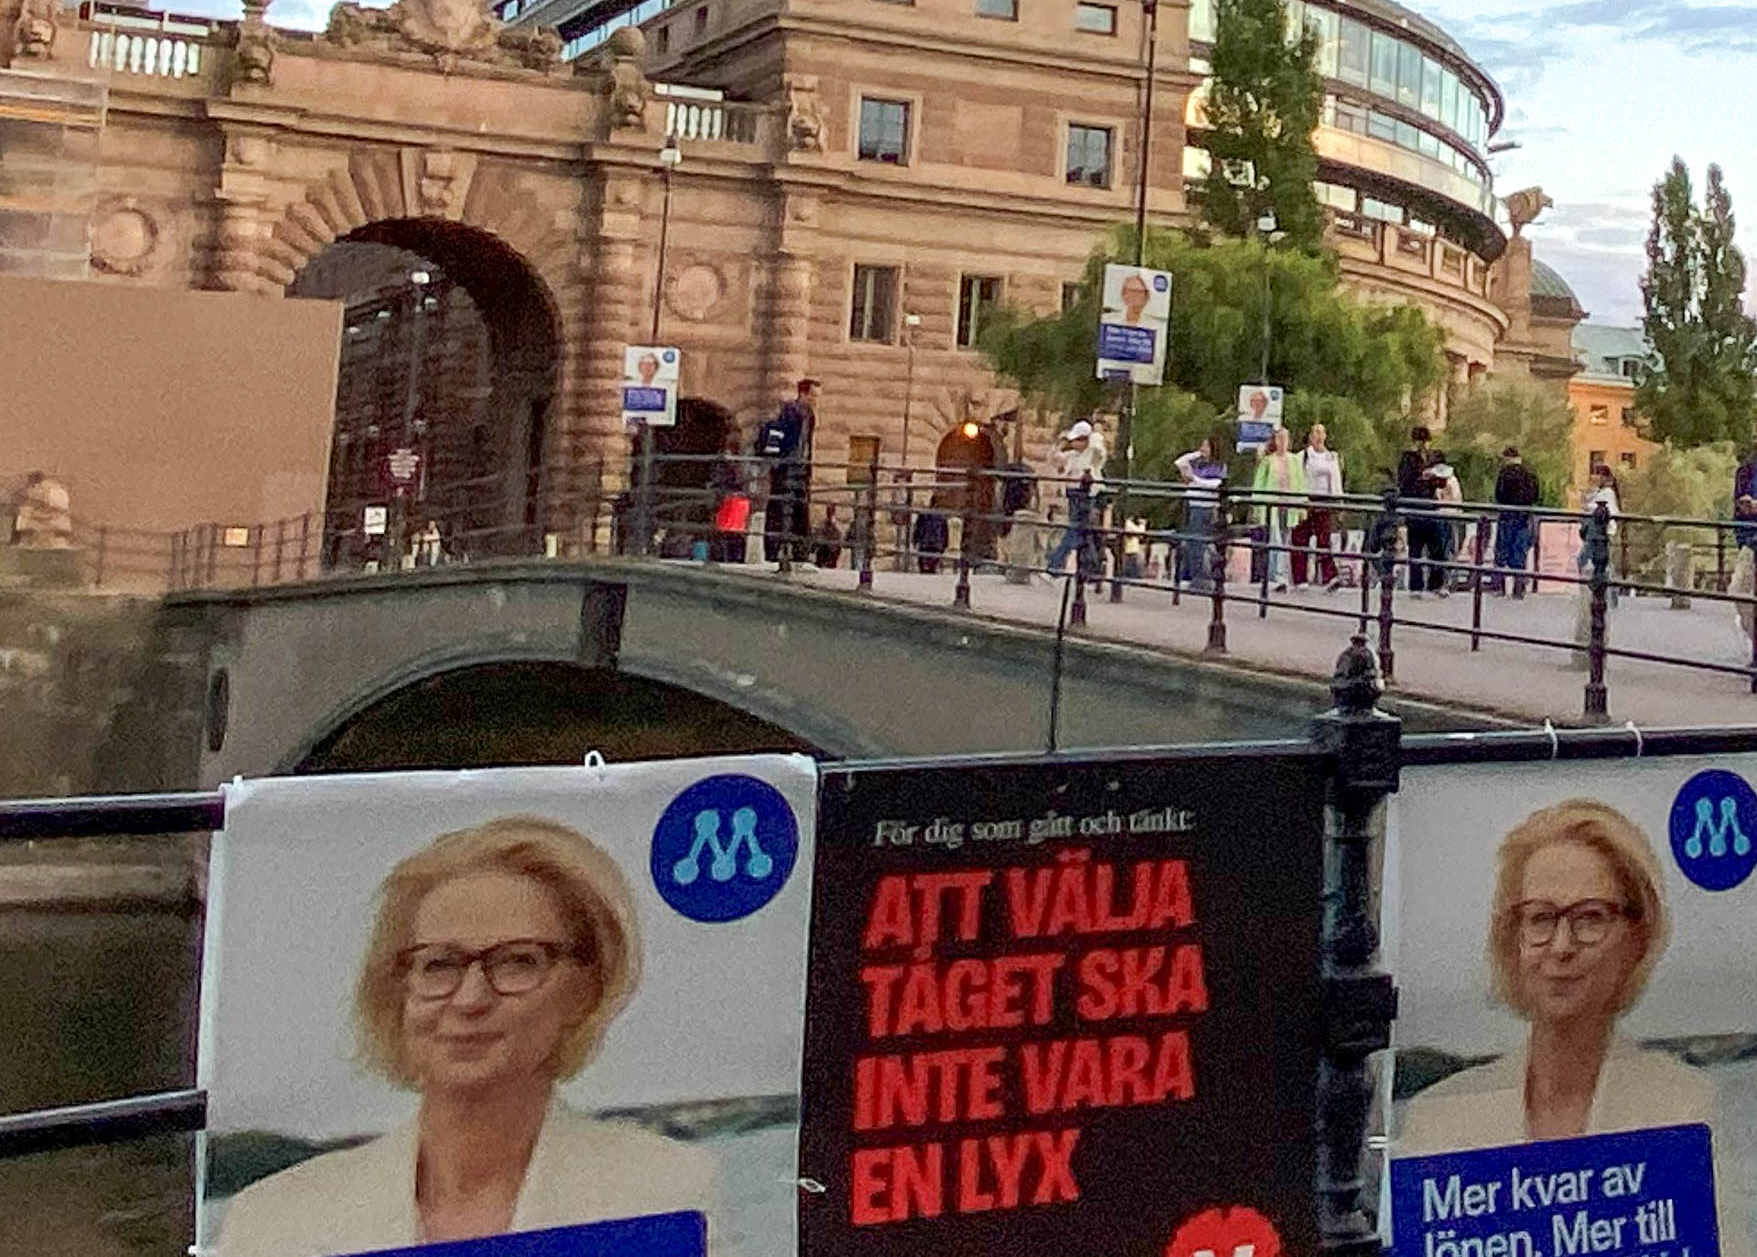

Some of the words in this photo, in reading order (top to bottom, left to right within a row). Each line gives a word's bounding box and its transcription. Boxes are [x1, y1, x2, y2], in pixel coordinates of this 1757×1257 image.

[875, 820, 922, 847] För
[925, 818, 965, 848] dig
[970, 820, 1021, 841] som
[1080, 809, 1122, 834] och
[863, 871, 993, 948] ATT
[1006, 847, 1195, 938] VÄLJA
[861, 946, 1066, 1038] TÅGET
[1077, 944, 1209, 1021] SKA
[854, 1047, 1005, 1130] INTE
[1021, 1030, 1195, 1114] VARA
[852, 1142, 943, 1226] EN
[959, 1129, 1082, 1213] LYX
[1423, 1175, 1501, 1222] Mer
[1512, 1167, 1594, 1210] kvar
[1602, 1162, 1646, 1198] av
[1552, 1211, 1627, 1256] Mer
[1635, 1199, 1676, 1244] till
